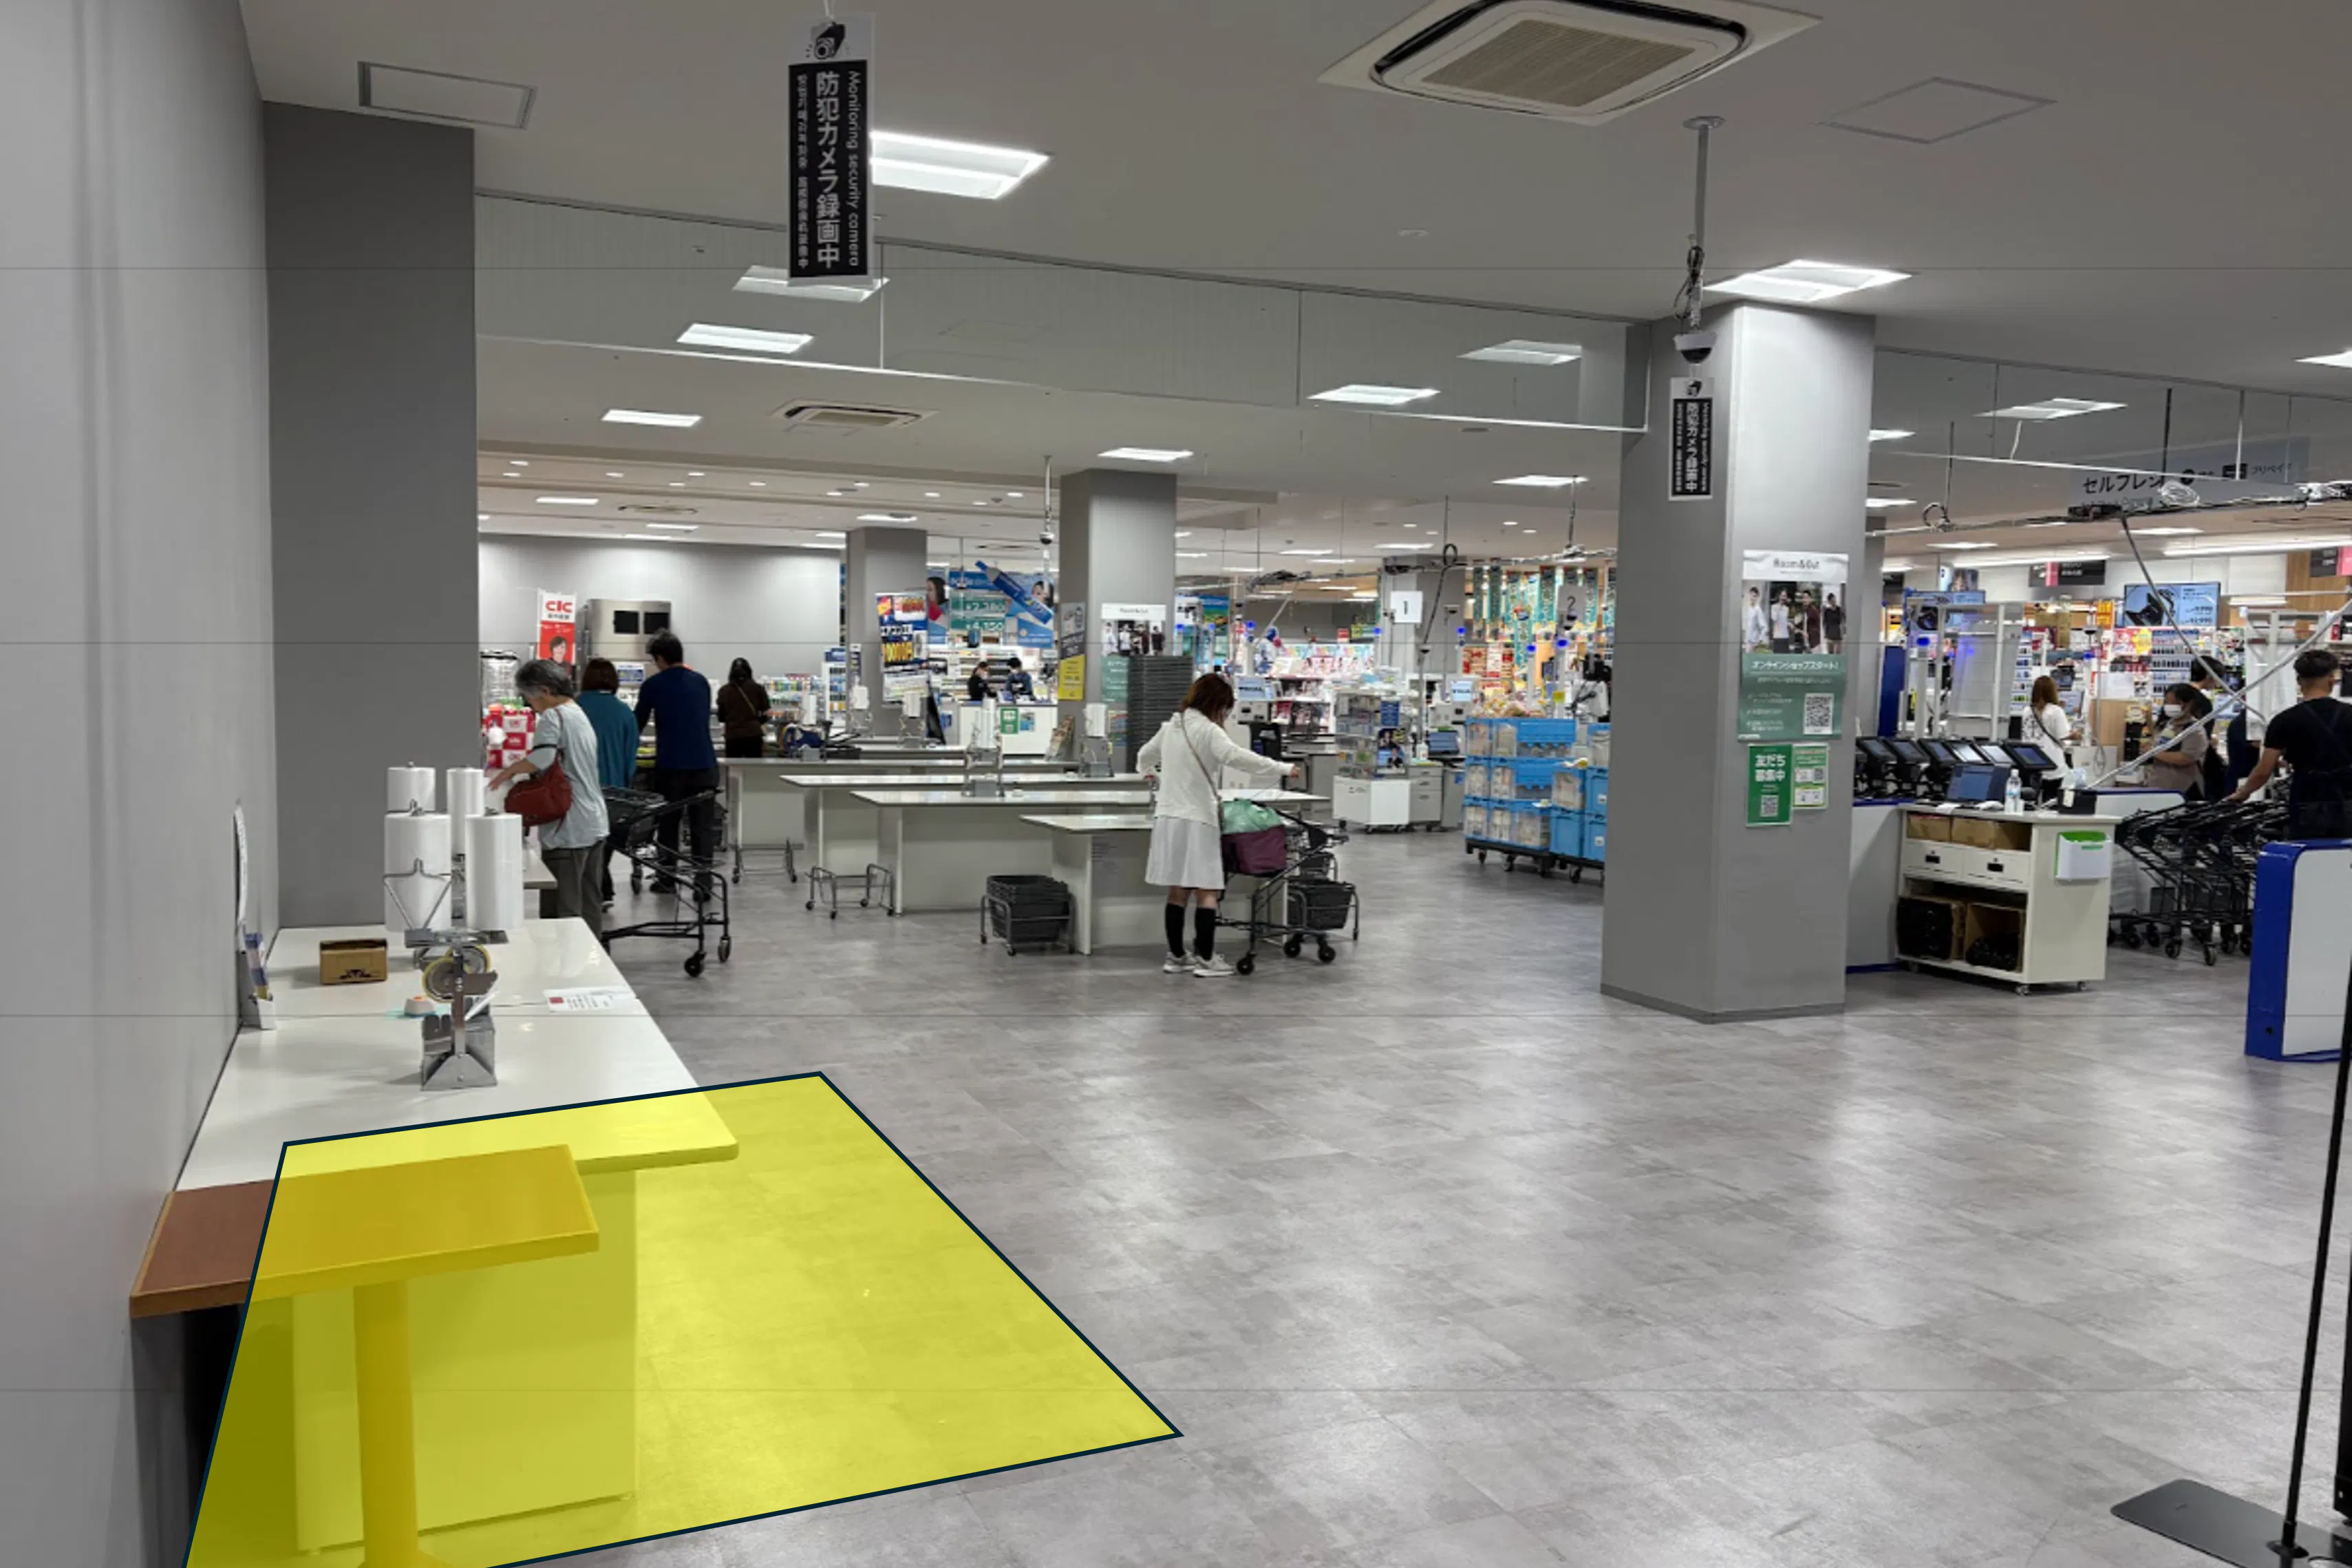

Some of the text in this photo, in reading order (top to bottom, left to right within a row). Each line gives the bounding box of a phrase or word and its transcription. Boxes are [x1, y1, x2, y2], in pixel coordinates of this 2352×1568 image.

[816, 72, 841, 269] 防犯カメラ録画中
[846, 71, 862, 266] Monitoring security camera
